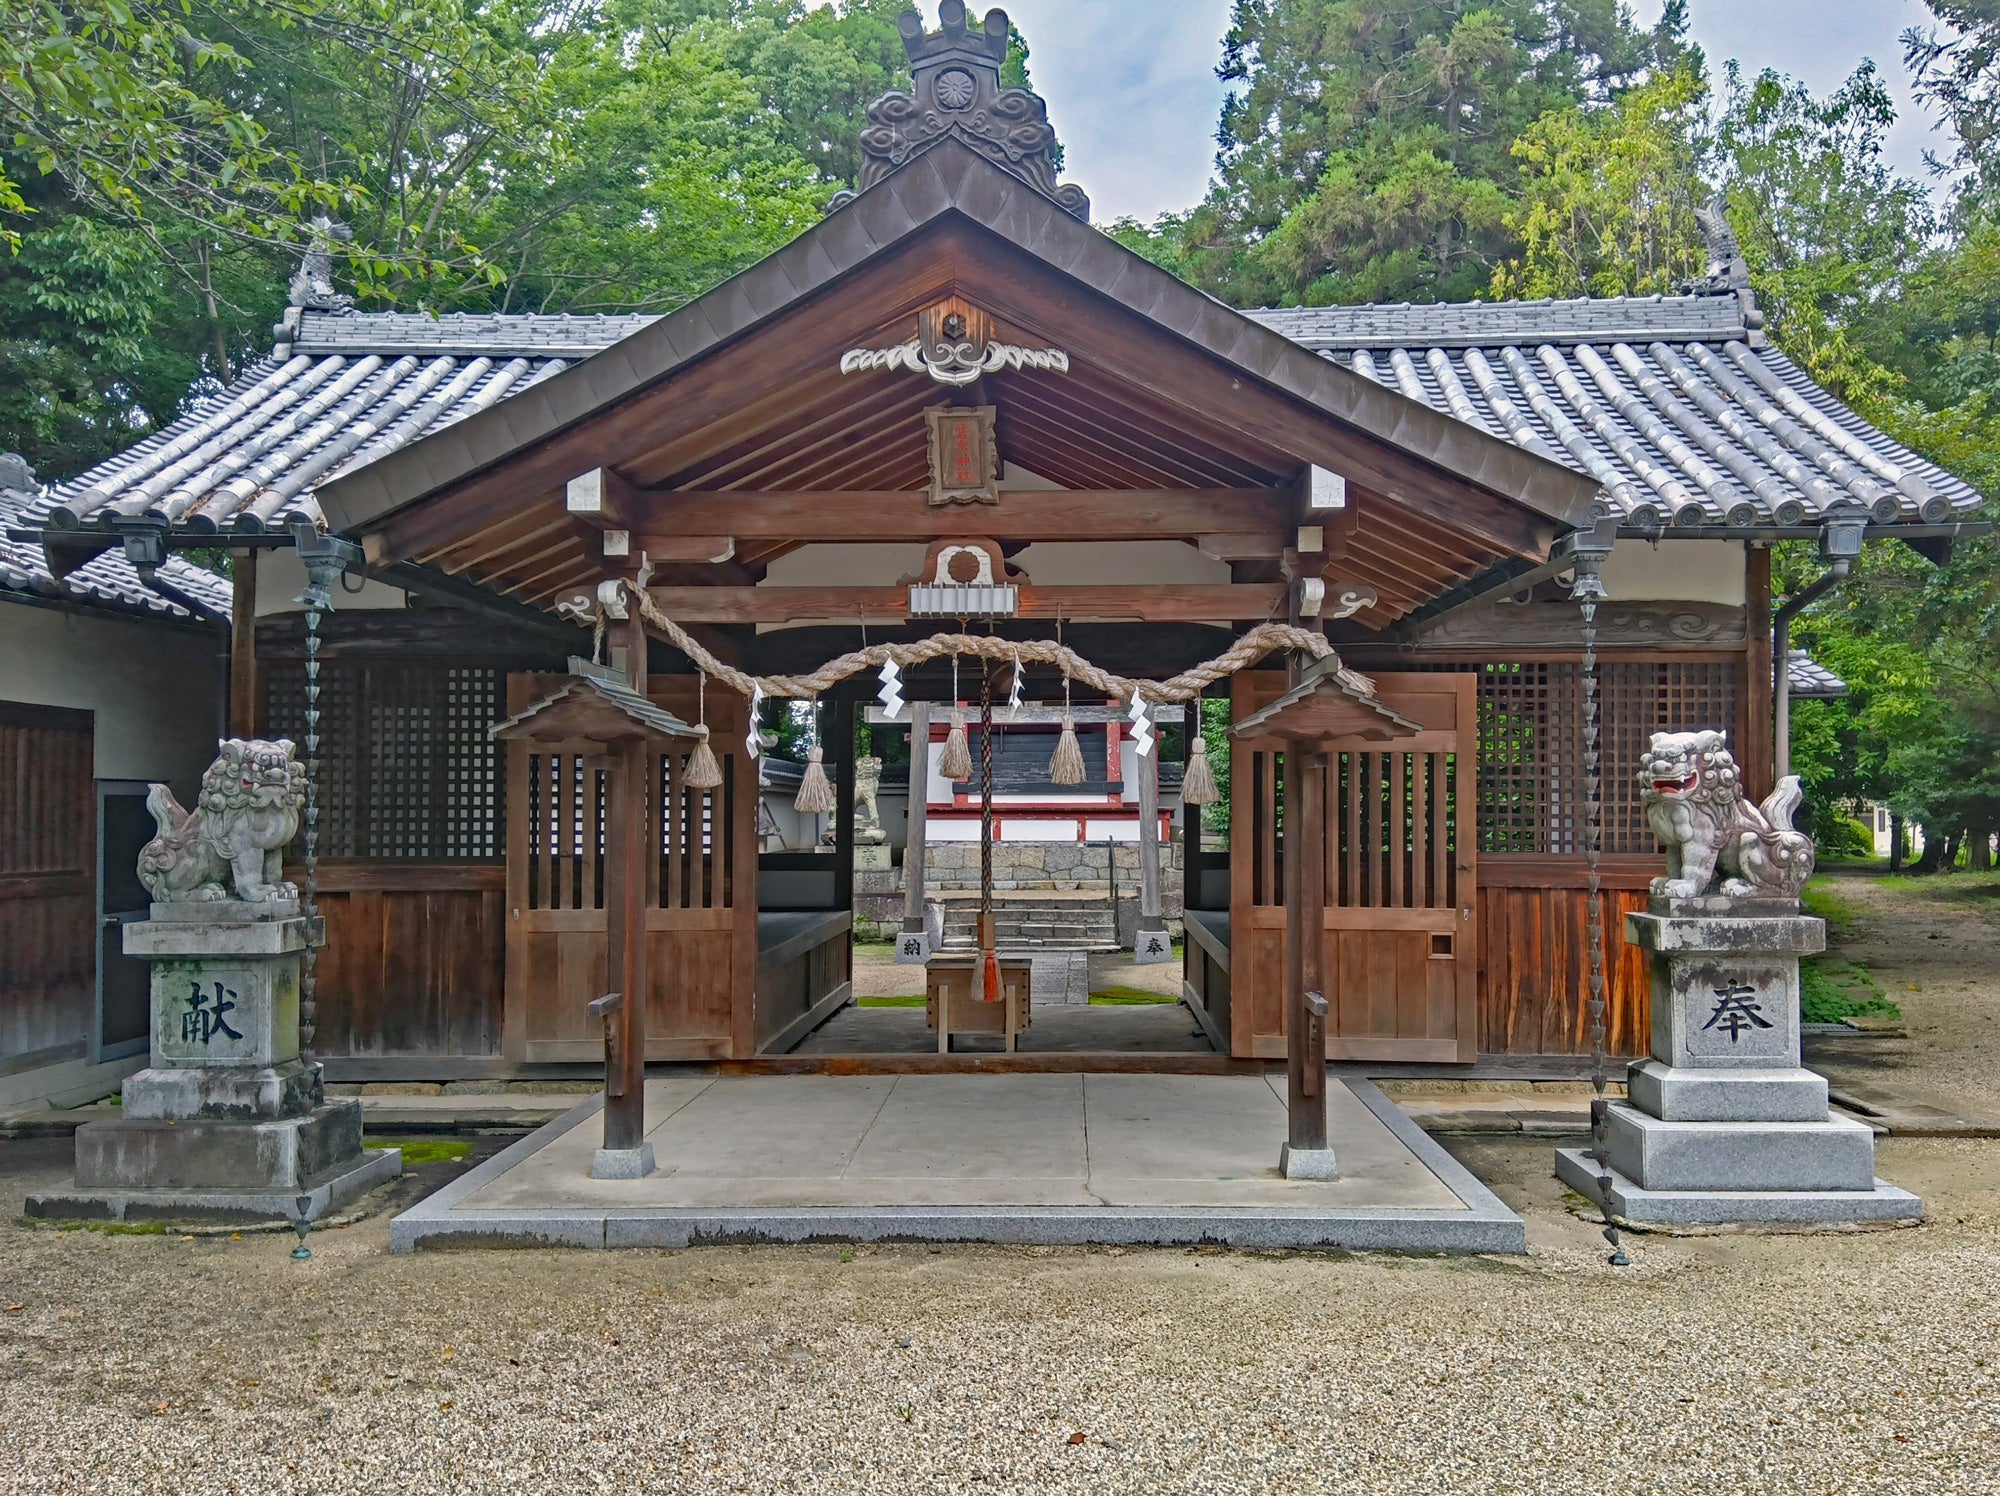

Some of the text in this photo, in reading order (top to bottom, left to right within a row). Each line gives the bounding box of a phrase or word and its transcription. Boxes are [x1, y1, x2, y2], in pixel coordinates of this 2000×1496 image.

[904, 938, 921, 956] 納
[1146, 937, 1164, 956] 奉
[182, 981, 243, 1045] 献
[1701, 978, 1774, 1044] 奉
